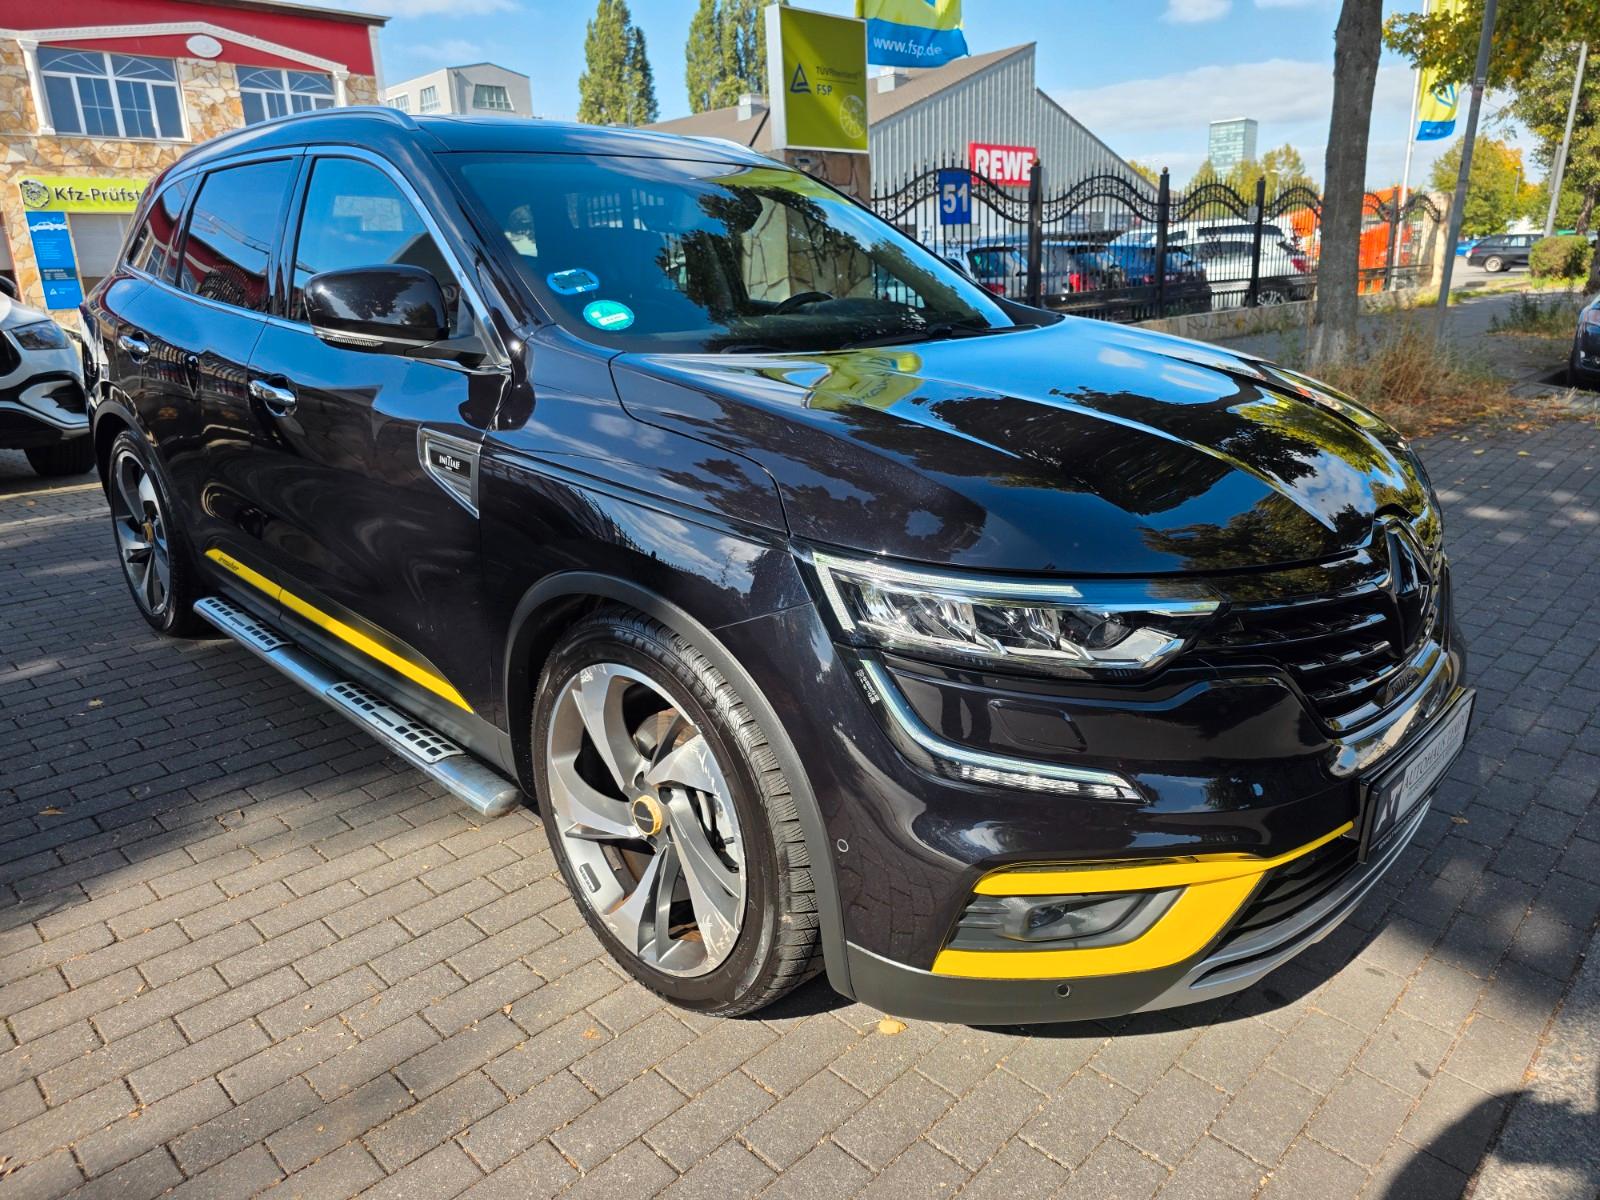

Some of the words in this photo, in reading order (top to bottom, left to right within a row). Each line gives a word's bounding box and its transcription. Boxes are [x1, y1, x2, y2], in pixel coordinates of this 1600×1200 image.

[873, 37, 942, 59] www.fsp.de
[816, 84, 833, 97] FSP
[975, 148, 1034, 181] REWE
[943, 183, 968, 214] 51
